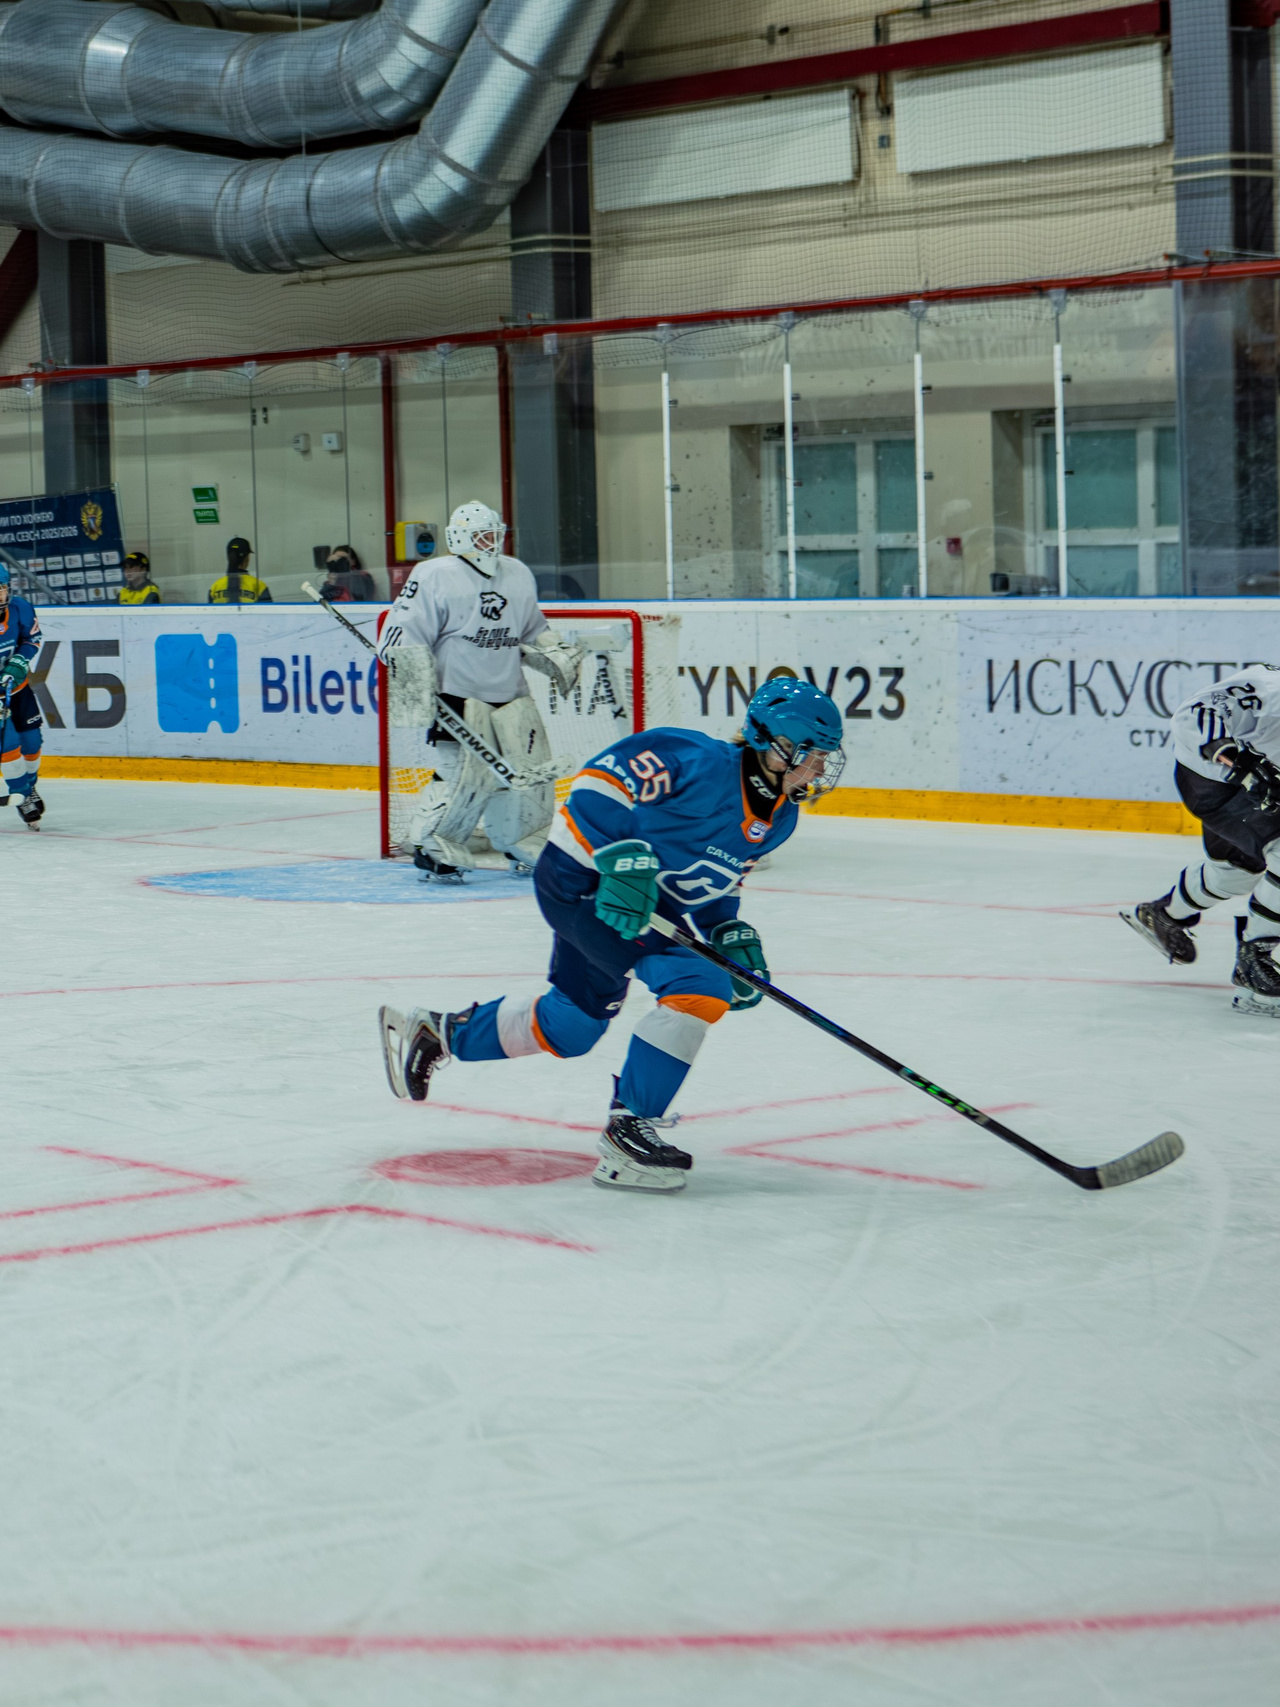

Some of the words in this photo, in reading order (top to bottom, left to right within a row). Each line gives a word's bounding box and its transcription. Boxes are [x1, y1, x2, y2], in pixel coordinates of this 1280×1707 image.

[1226, 682, 1262, 711] 26
[436, 703, 516, 784] HERWOO
[1129, 729, 1171, 747] СТУ
[628, 749, 673, 803] 55
